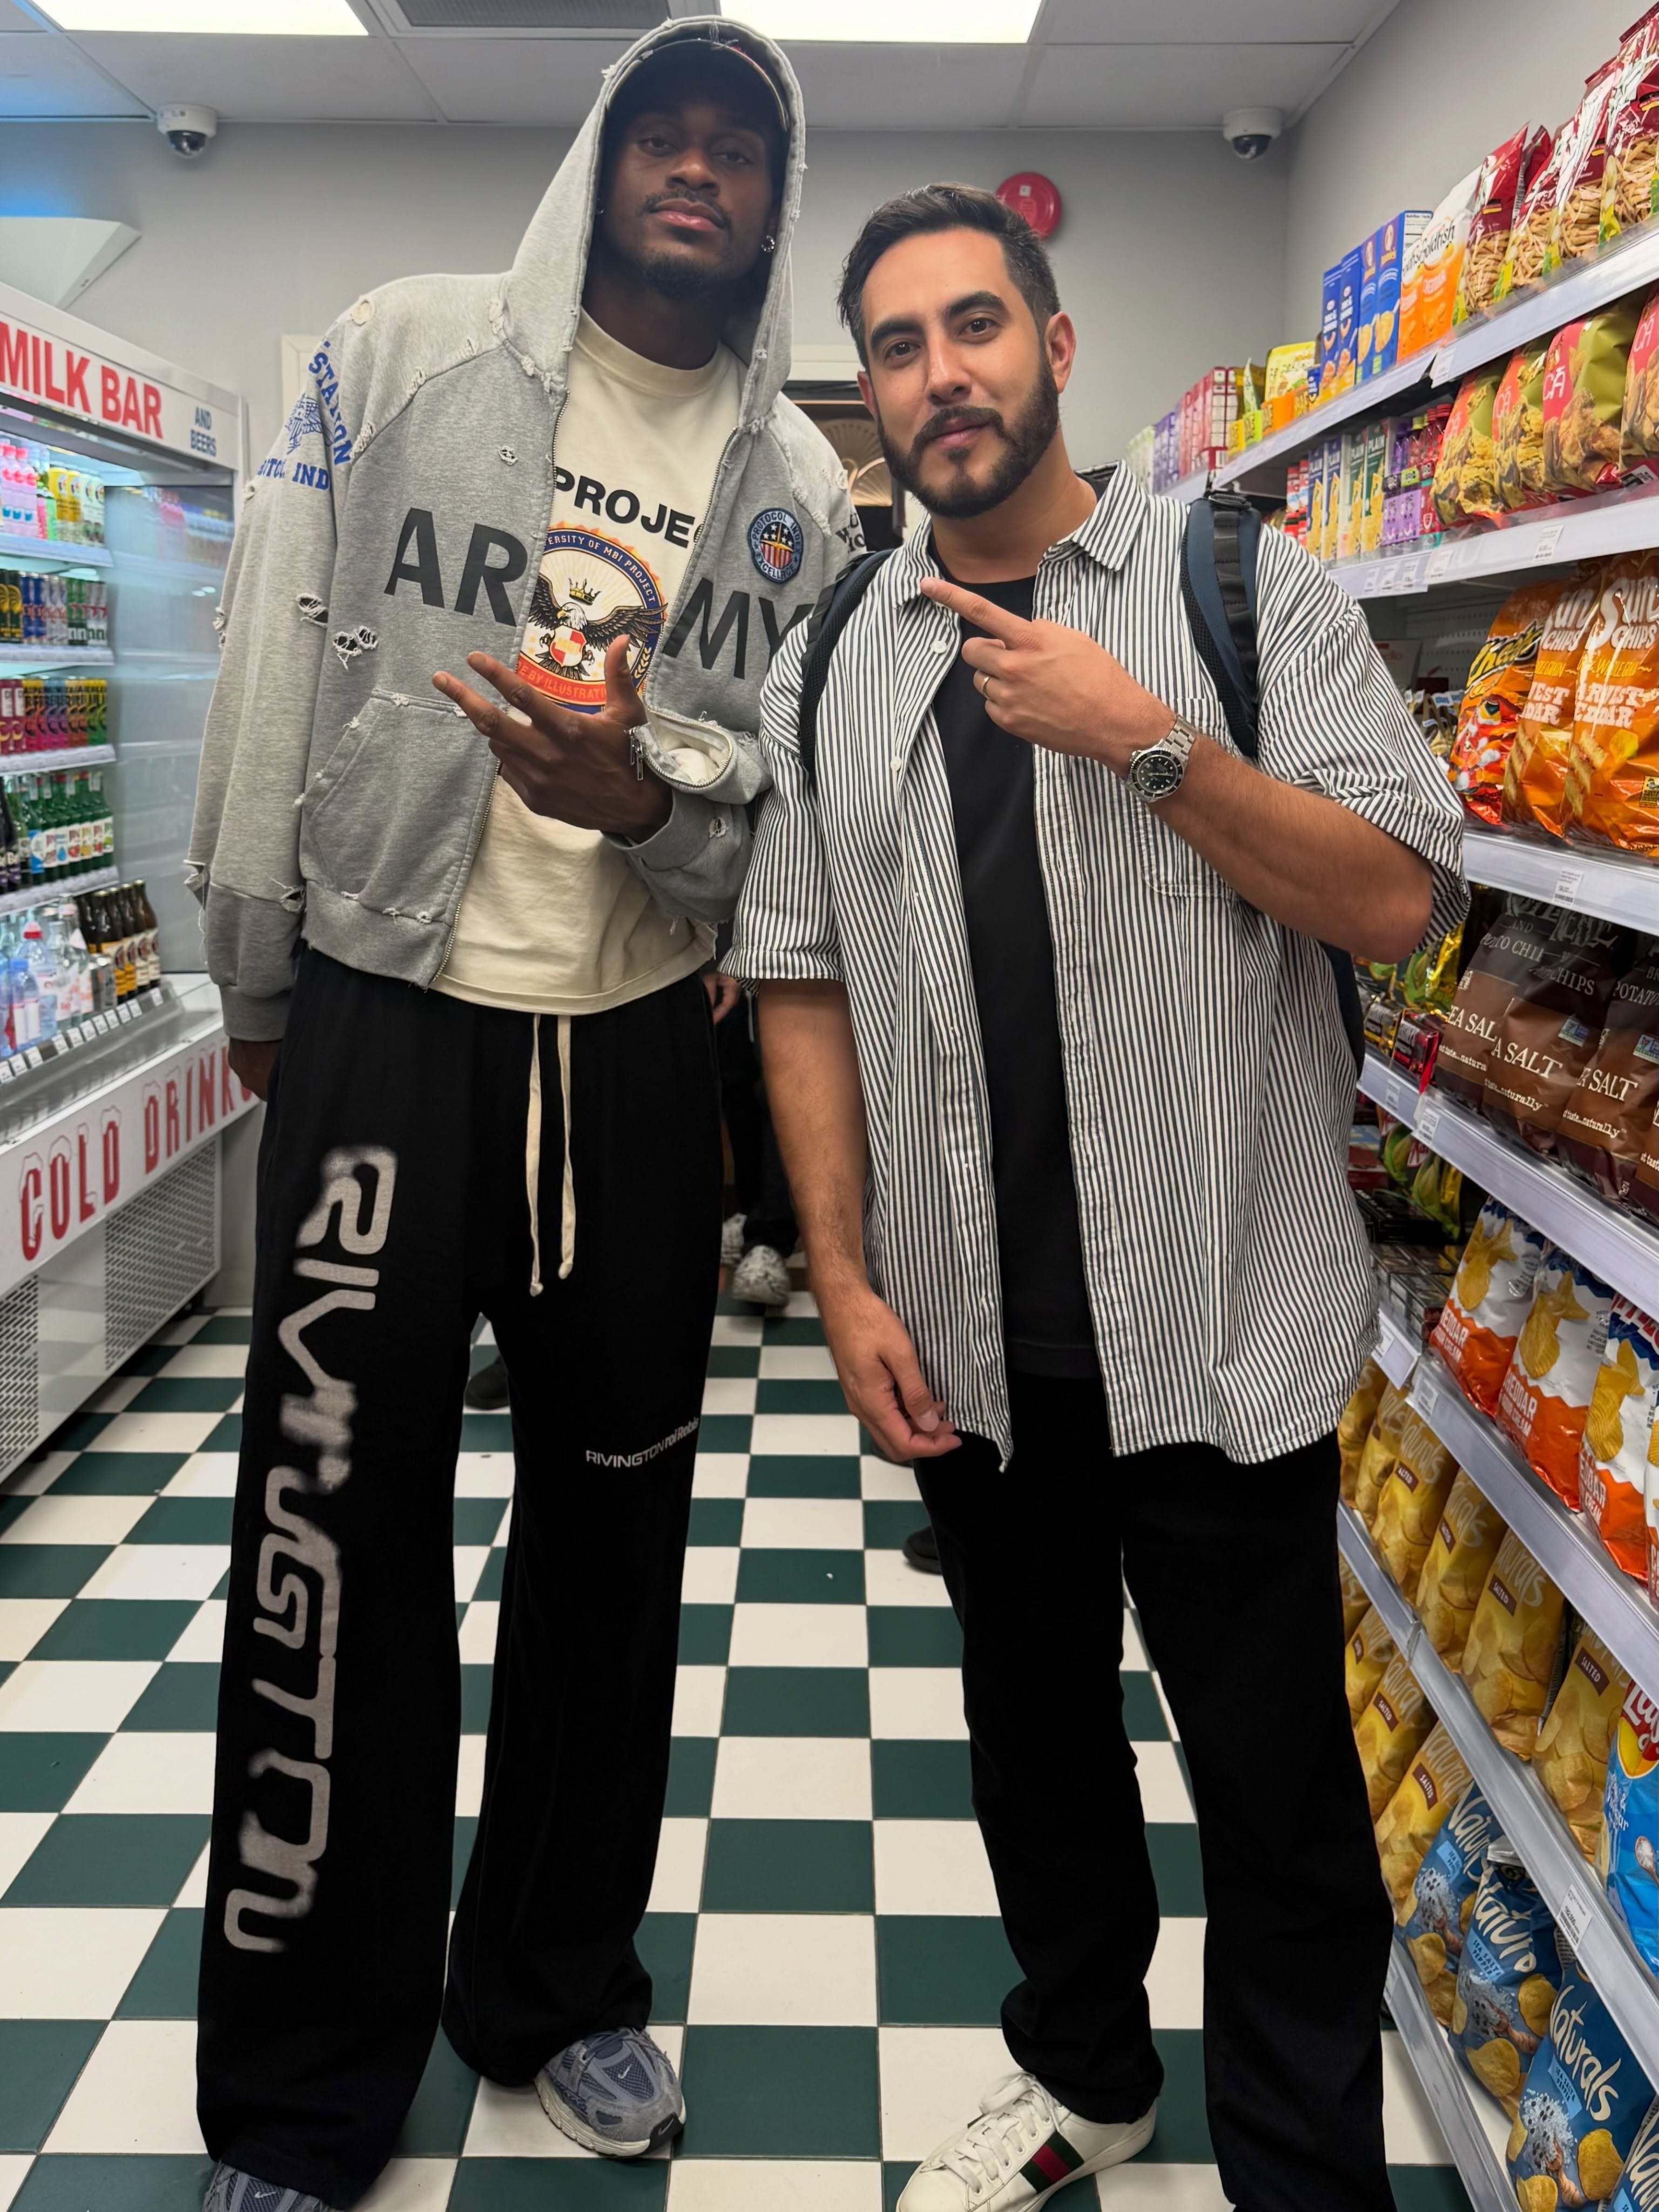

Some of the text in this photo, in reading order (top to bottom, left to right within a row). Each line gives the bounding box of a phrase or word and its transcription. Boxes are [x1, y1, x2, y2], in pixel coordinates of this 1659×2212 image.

[0, 322, 163, 439] MILK BAR
[194, 406, 212, 430] AND
[190, 429, 217, 457] BEERS
[1368, 435, 1385, 448] PLAIN
[554, 466, 704, 549] PROJE
[752, 511, 787, 541] PROTOCOL
[546, 534, 656, 603] ERSITY OF MBI PROJECT
[1611, 625, 1657, 650] CHIPS
[528, 671, 542, 686] BY
[1505, 1042, 1563, 1079] SALT
[1589, 1069, 1638, 1102] SALT
[19, 1041, 252, 1260] COLD DRINK
[585, 1439, 664, 1468] RIVINGTON
[1493, 1582, 1509, 1604] SALTED
[1581, 1656, 1601, 1683] SALTED
[1378, 1699, 1392, 1721] SALTED
[1419, 1773, 1434, 1800] SALTED
[1473, 1940, 1483, 1953] SEA
